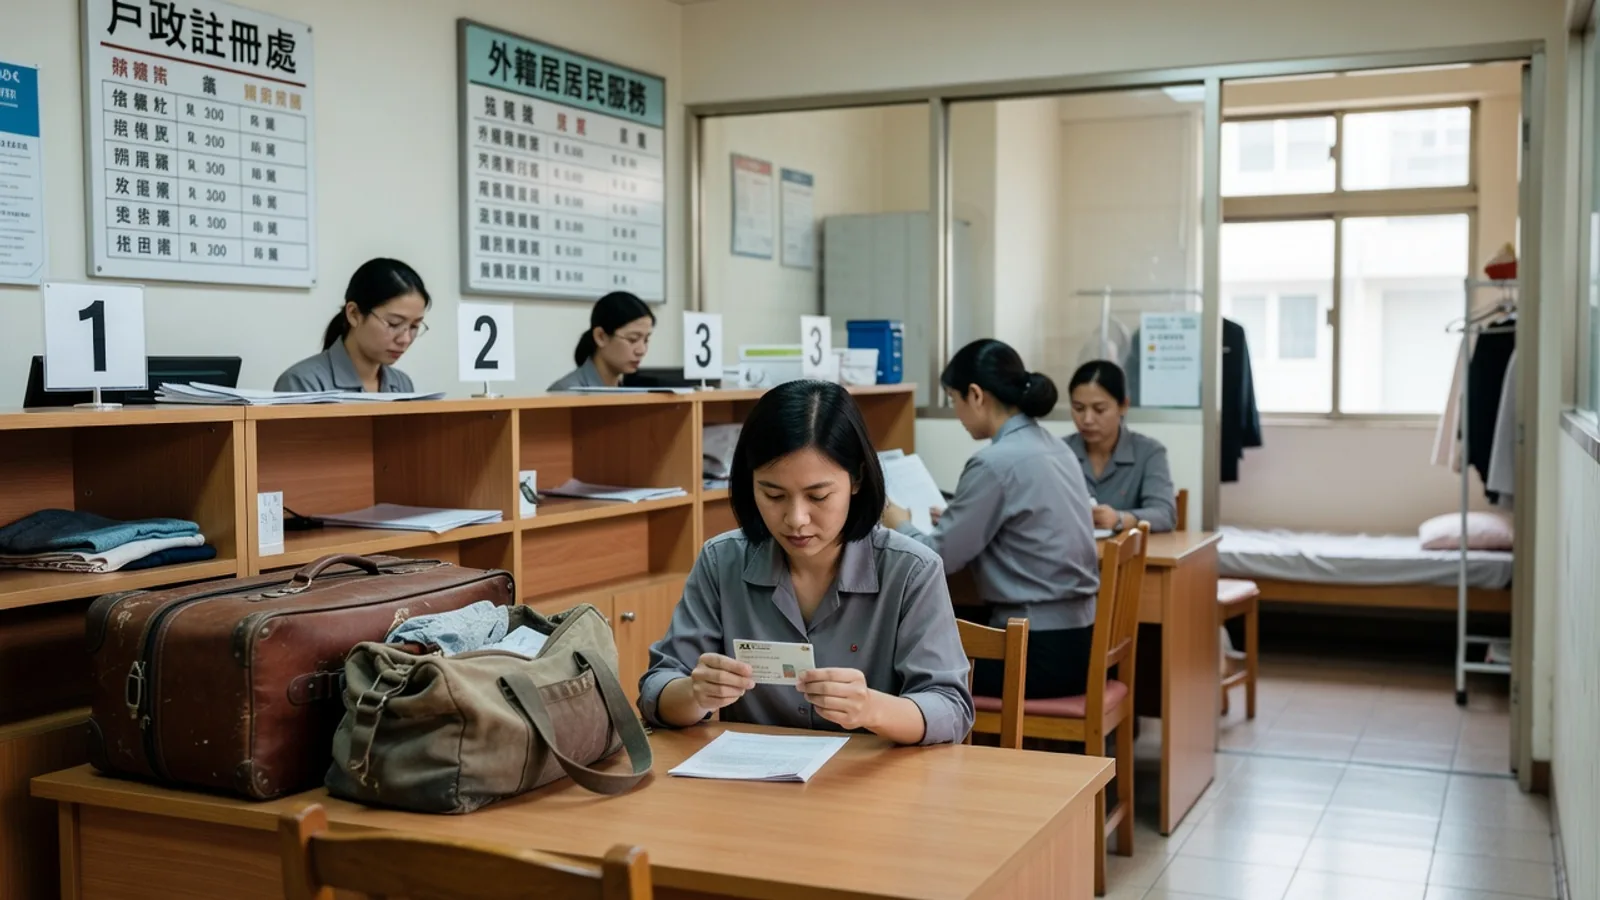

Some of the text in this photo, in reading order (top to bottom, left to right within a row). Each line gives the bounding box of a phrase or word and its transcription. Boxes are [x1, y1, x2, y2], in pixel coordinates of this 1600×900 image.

[488, 40, 646, 116] 外籍居居民服務
[78, 300, 107, 372] 1
[474, 315, 499, 370] 2
[695, 323, 712, 368] 3
[810, 326, 823, 367] 3
